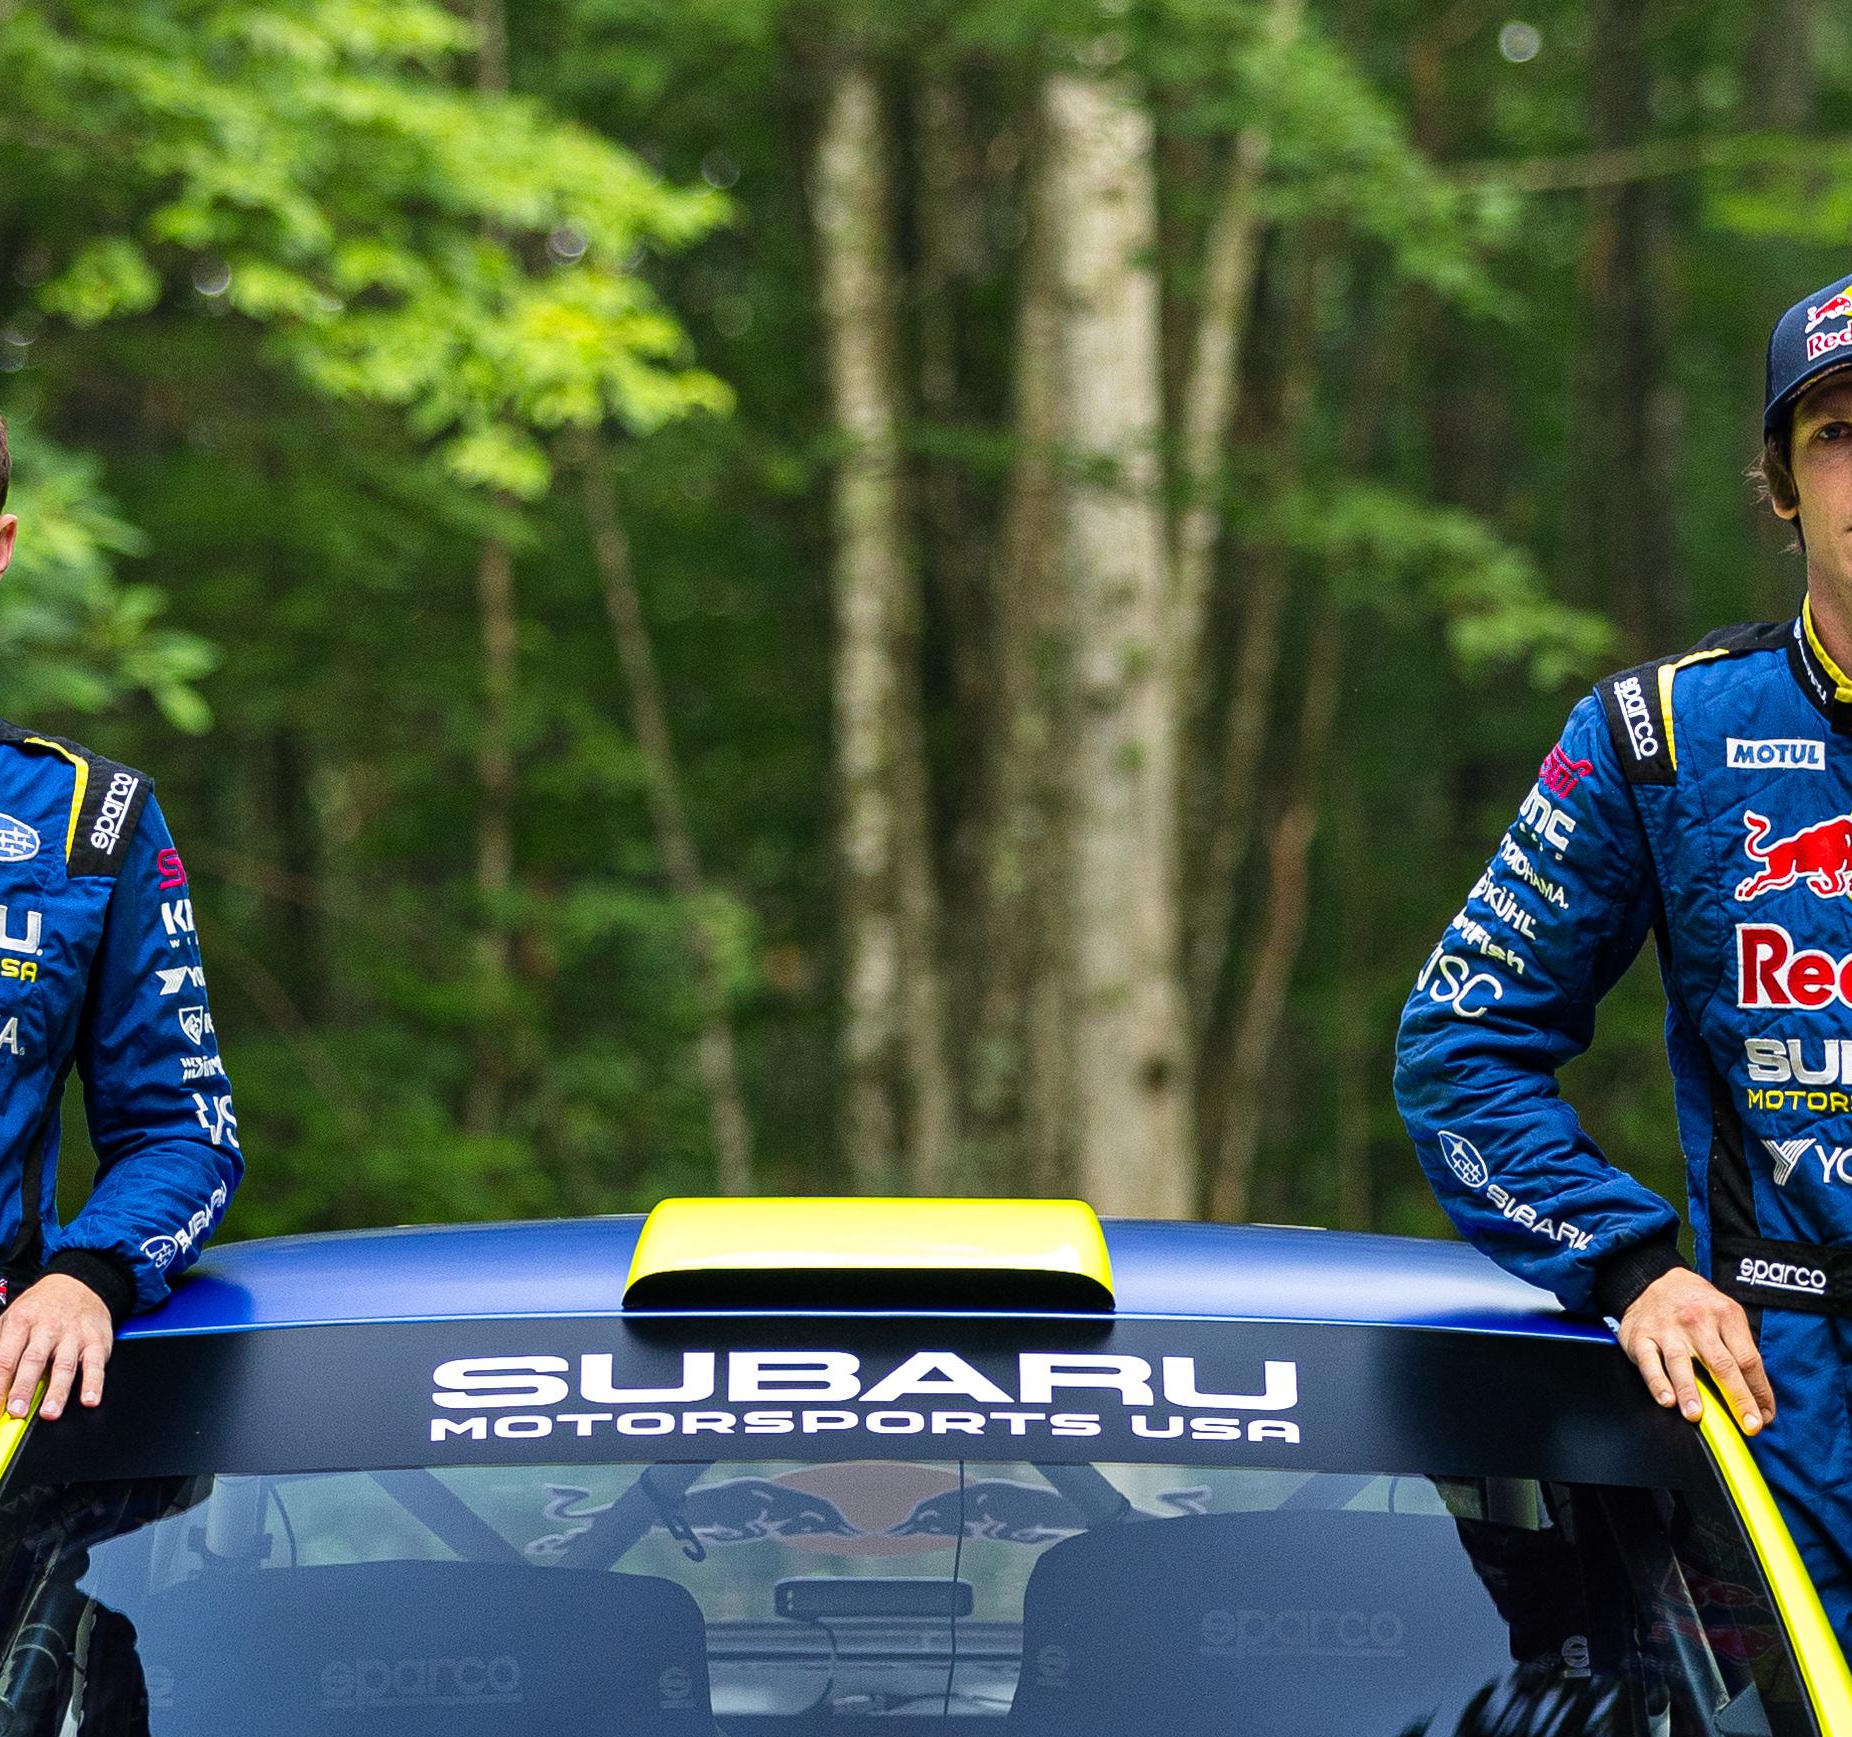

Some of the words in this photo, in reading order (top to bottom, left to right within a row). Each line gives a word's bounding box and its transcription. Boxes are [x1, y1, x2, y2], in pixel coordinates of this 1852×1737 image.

[1613, 676, 1659, 761] sparco
[1733, 743, 1820, 765] MOTUL
[90, 772, 140, 856] sparco
[1736, 1256, 1827, 1295] sparco
[432, 1351, 1299, 1411] SUBARU
[431, 1409, 1102, 1441] MOTORSPORTS
[1131, 1414, 1301, 1444] USA
